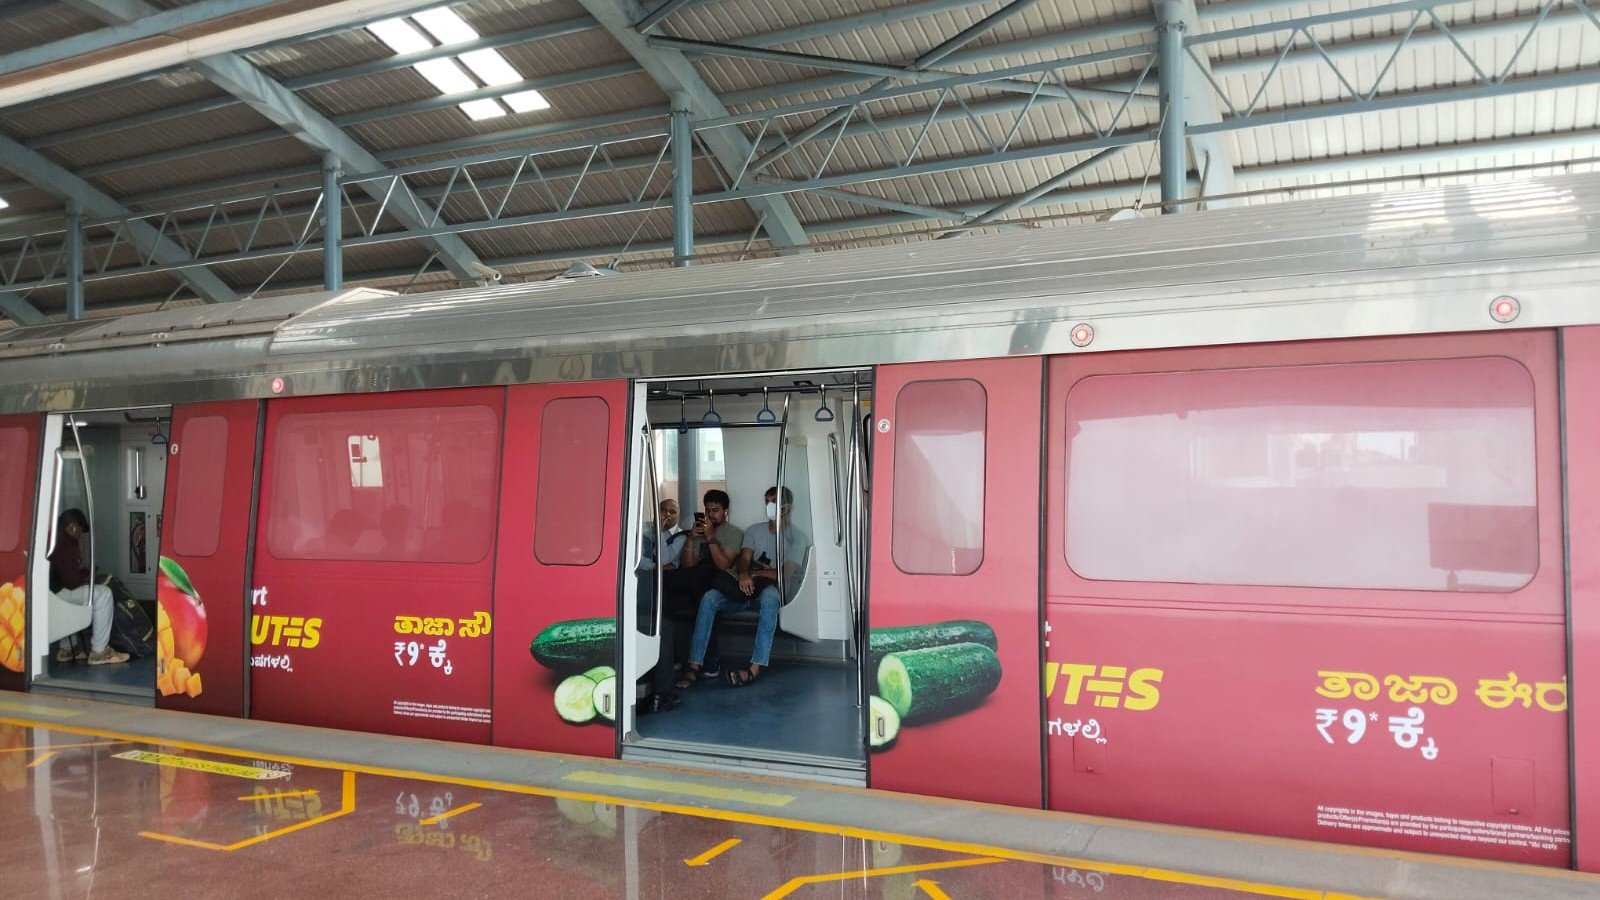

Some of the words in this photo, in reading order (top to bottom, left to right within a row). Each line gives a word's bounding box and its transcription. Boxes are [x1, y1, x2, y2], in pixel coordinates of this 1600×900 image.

[393, 615, 455, 637] ತಾಜಾ
[1315, 669, 1459, 706] ತಾಜಾ
[1388, 706, 1439, 760] ಕ್ಕೆ
